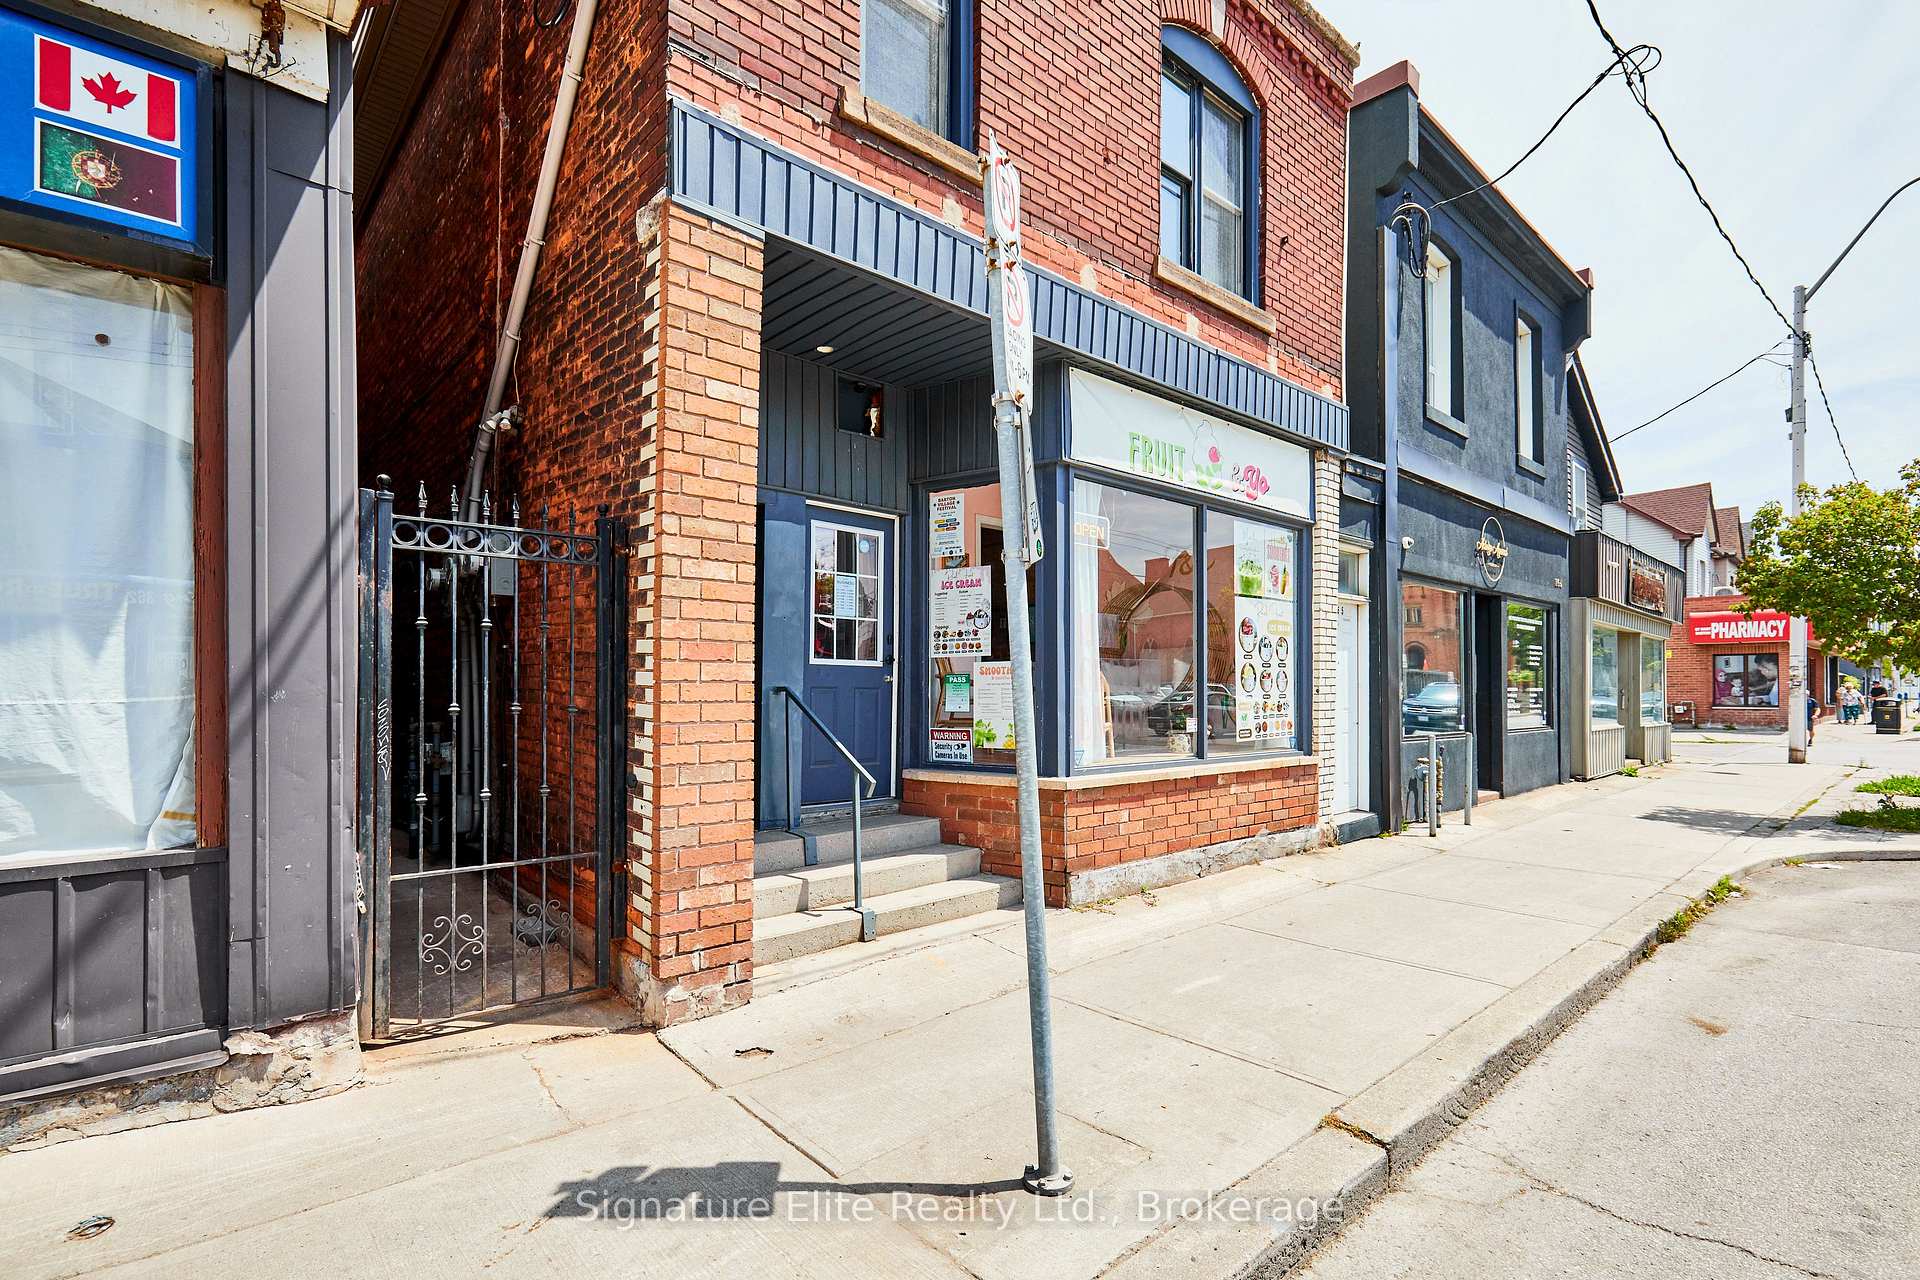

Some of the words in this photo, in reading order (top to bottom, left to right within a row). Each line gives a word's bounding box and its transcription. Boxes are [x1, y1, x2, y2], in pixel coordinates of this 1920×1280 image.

[1128, 431, 1186, 482] FRUIT
[1074, 521, 1105, 541] OPEN
[941, 580, 954, 591] ICE
[955, 578, 982, 589] CREAM
[1711, 619, 1786, 639] PHARMACY
[933, 731, 968, 740] WARNING
[934, 742, 953, 752] Security
[934, 751, 953, 760] Cameras
[953, 751, 959, 760] In
[959, 752, 968, 760] Use
